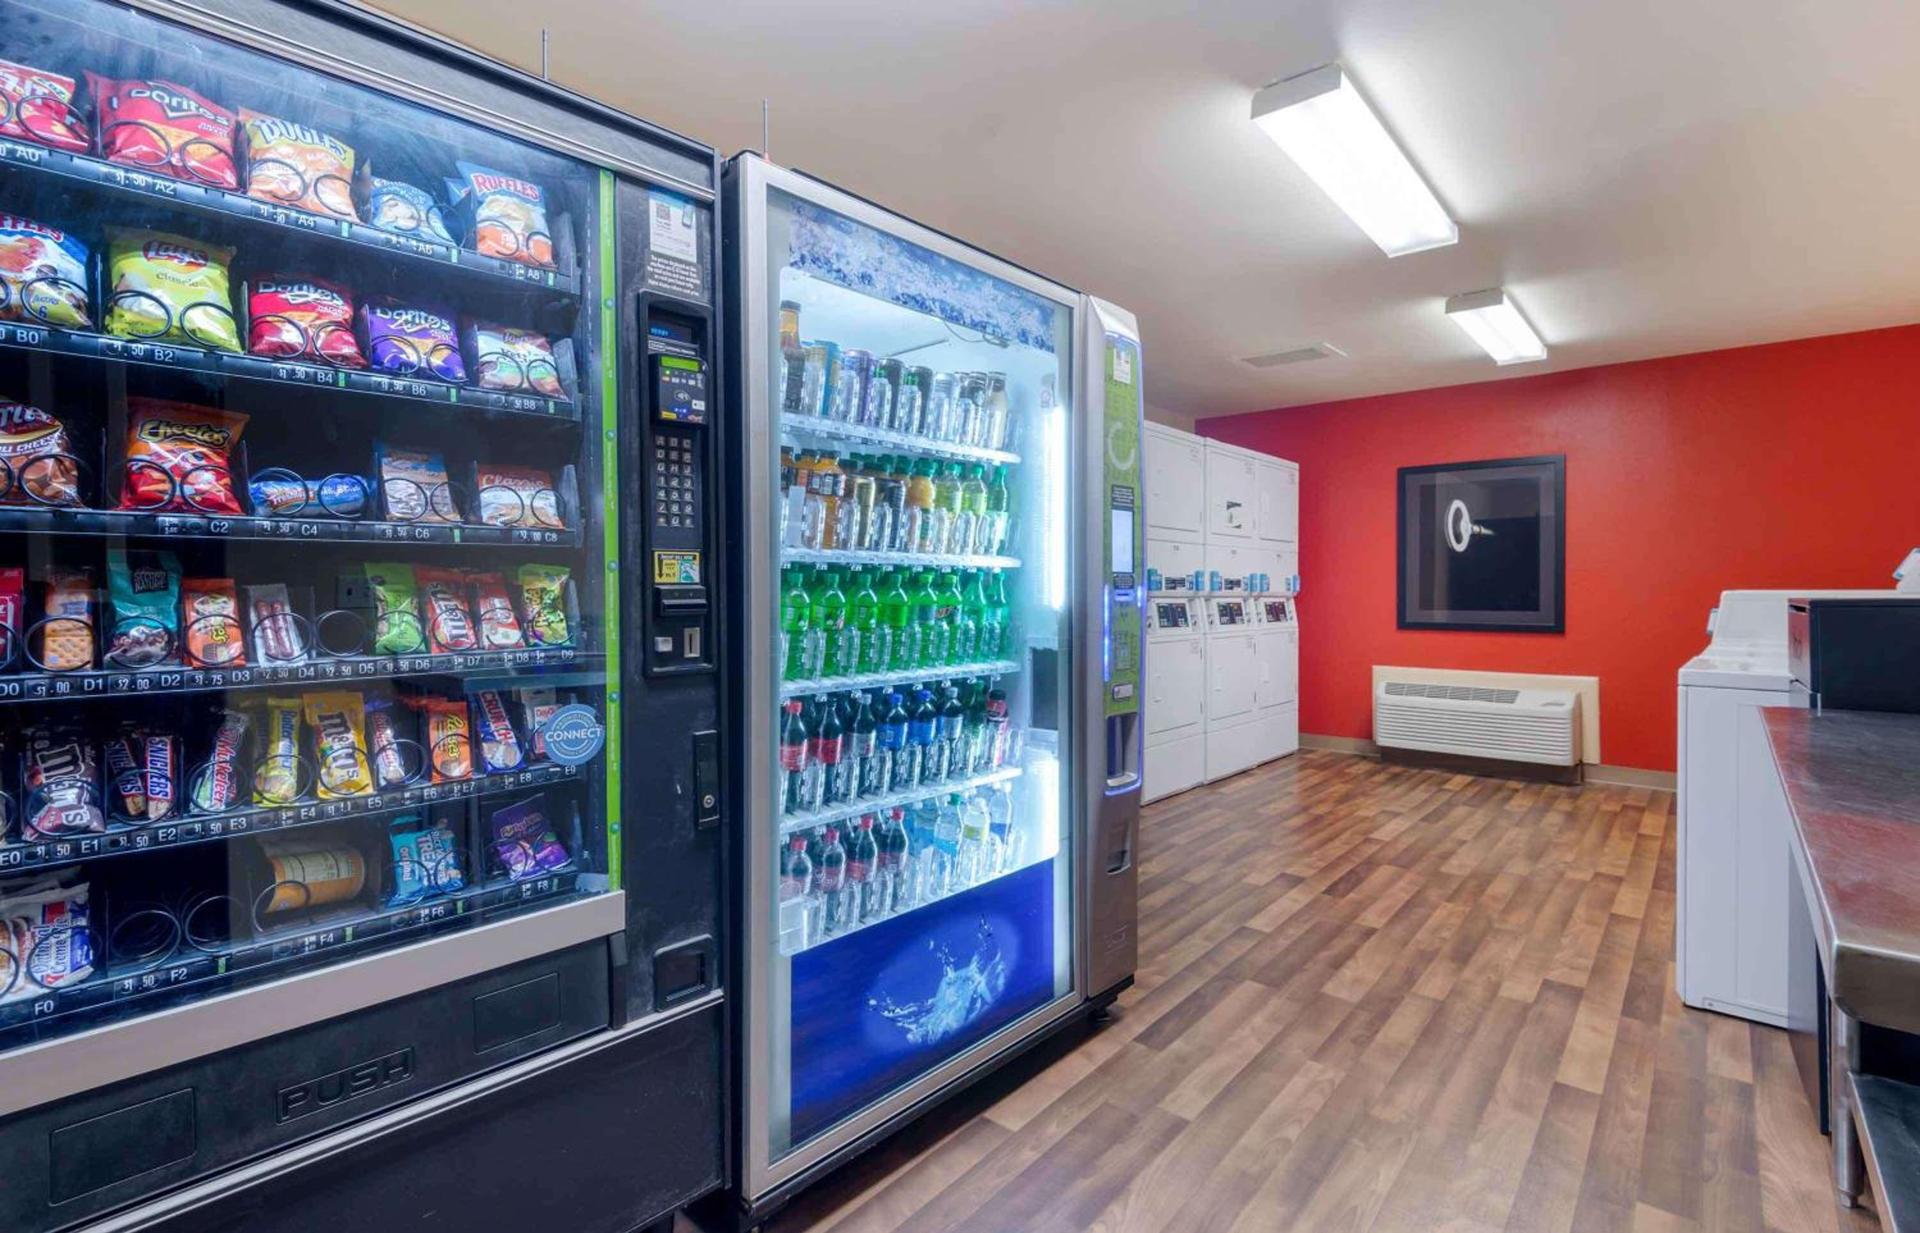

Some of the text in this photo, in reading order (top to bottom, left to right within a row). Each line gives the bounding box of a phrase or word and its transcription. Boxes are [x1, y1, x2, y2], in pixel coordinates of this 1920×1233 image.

[130, 86, 230, 127] Doritos
[256, 119, 347, 160] BUGLES
[155, 180, 174, 195] A2
[471, 171, 541, 202] RUFFLES
[375, 307, 452, 332] Doritos
[17, 329, 39, 345] B0
[154, 351, 174, 364] B2
[316, 371, 333, 383] B4
[411, 383, 427, 396] B6
[141, 419, 230, 447] Cheetos
[210, 521, 228, 534] C2
[300, 524, 317, 536] C4
[415, 527, 430, 539] C6
[359, 662, 375, 674] D5
[414, 659, 430, 671] D6
[467, 656, 480, 667] D7
[231, 670, 250, 683] D3
[298, 667, 315, 679] D4
[84, 677, 104, 691] D1
[118, 674, 180, 691] $2.00 D2
[545, 727, 602, 743] CONNECT
[423, 788, 437, 800] E6
[462, 782, 475, 793] E7
[367, 797, 382, 809] E5
[300, 807, 315, 820] E4
[230, 818, 246, 831] E3
[158, 828, 176, 842] E2
[81, 839, 99, 855] E1
[537, 880, 549, 890] F8
[432, 906, 444, 919] F6
[320, 933, 334, 946] F4
[170, 968, 187, 983] F2
[34, 1000, 54, 1016] F0
[282, 1056, 409, 1120] PUSH
